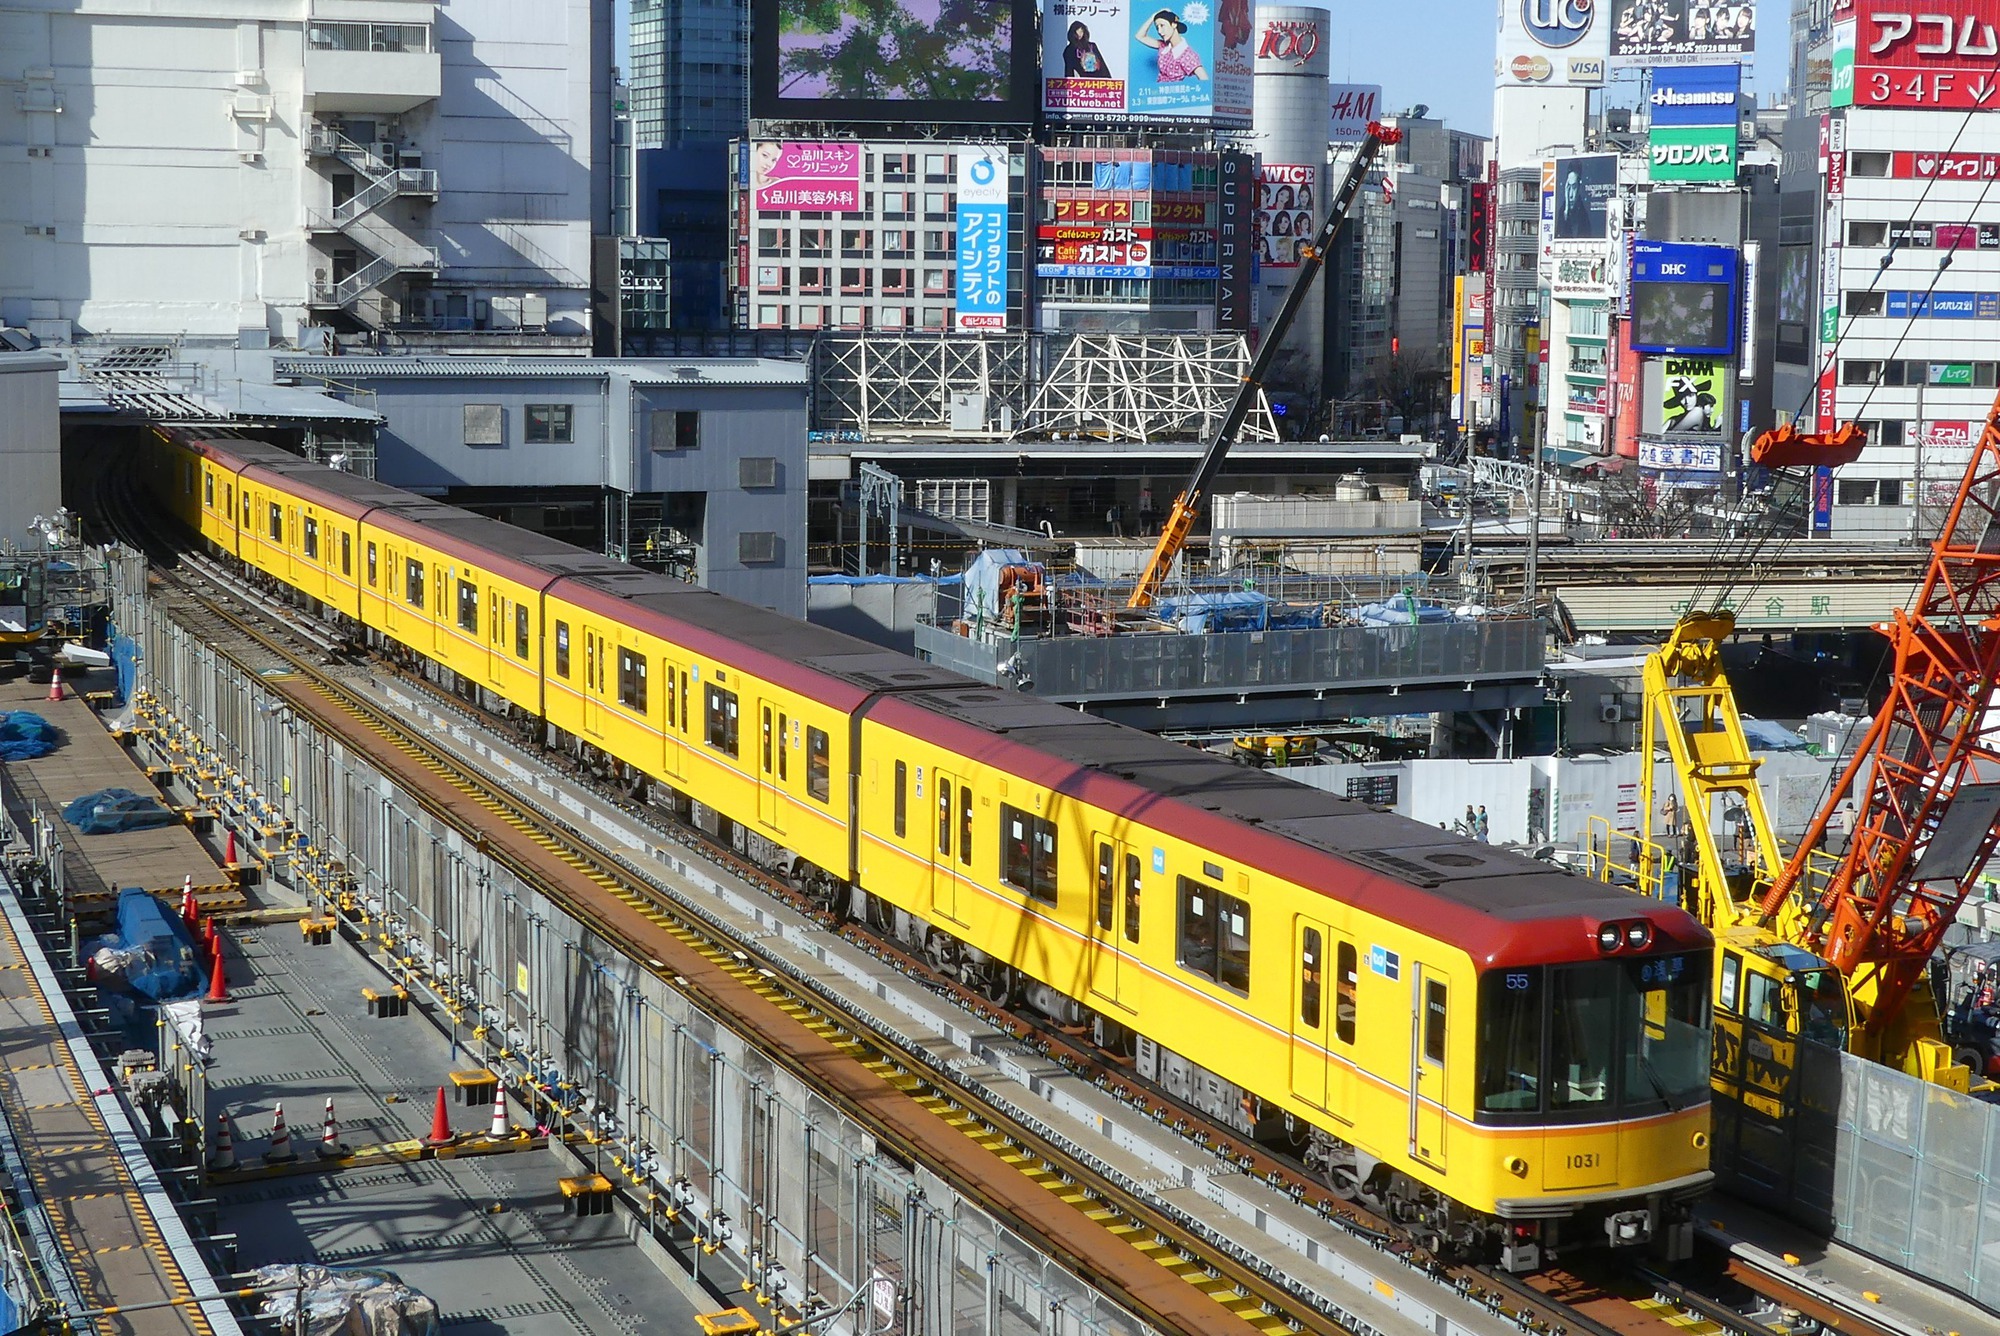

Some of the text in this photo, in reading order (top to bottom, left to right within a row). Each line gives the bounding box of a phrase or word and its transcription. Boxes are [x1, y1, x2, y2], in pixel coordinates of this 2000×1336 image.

[1053, 4, 1120, 17] 横浜アリーナ
[1268, 21, 1316, 29] SHIBUYA
[1870, 13, 1998, 56] アコム
[1258, 29, 1320, 67] 109
[1511, 63, 1550, 72] MasterCard
[1571, 63, 1600, 74] VISA
[1048, 80, 1123, 90] オフィシャルHP先行
[1833, 64, 1853, 91] レイク
[1055, 98, 1121, 108] YUKIweb.net
[1650, 88, 1735, 106] Hisamitsu
[1332, 92, 1375, 120] H&M
[801, 150, 854, 162] 品川スキン
[1652, 145, 1730, 166] サロンパス
[802, 163, 849, 173] クリニック
[1261, 167, 1314, 183] WICE
[1831, 161, 1841, 193] アイフル
[771, 191, 854, 206] 品川美容外科
[964, 188, 1001, 199] eyecity
[1152, 203, 1203, 219] コンタクト
[1102, 228, 1138, 241] ガスト
[1189, 230, 1214, 243] ガスト
[1221, 161, 1236, 321] SUPERMAN
[962, 213, 983, 305] アイシティ
[986, 213, 1001, 305] コンタクトの
[1079, 245, 1123, 262] ガスト
[1067, 265, 1131, 276] 英会話イーオン
[1661, 264, 1686, 275] DHC
[620, 277, 663, 286] CITY
[1933, 301, 1973, 311] レオパレス21
[1825, 312, 1834, 339] レイク
[1666, 361, 1714, 376] DMM
[1946, 369, 1969, 379] レイク
[1664, 376, 1698, 393] FX
[1821, 389, 1831, 416] アコム
[1934, 428, 1967, 439] アコム
[1506, 974, 1529, 990] 55
[1567, 1153, 1600, 1170] 1031
